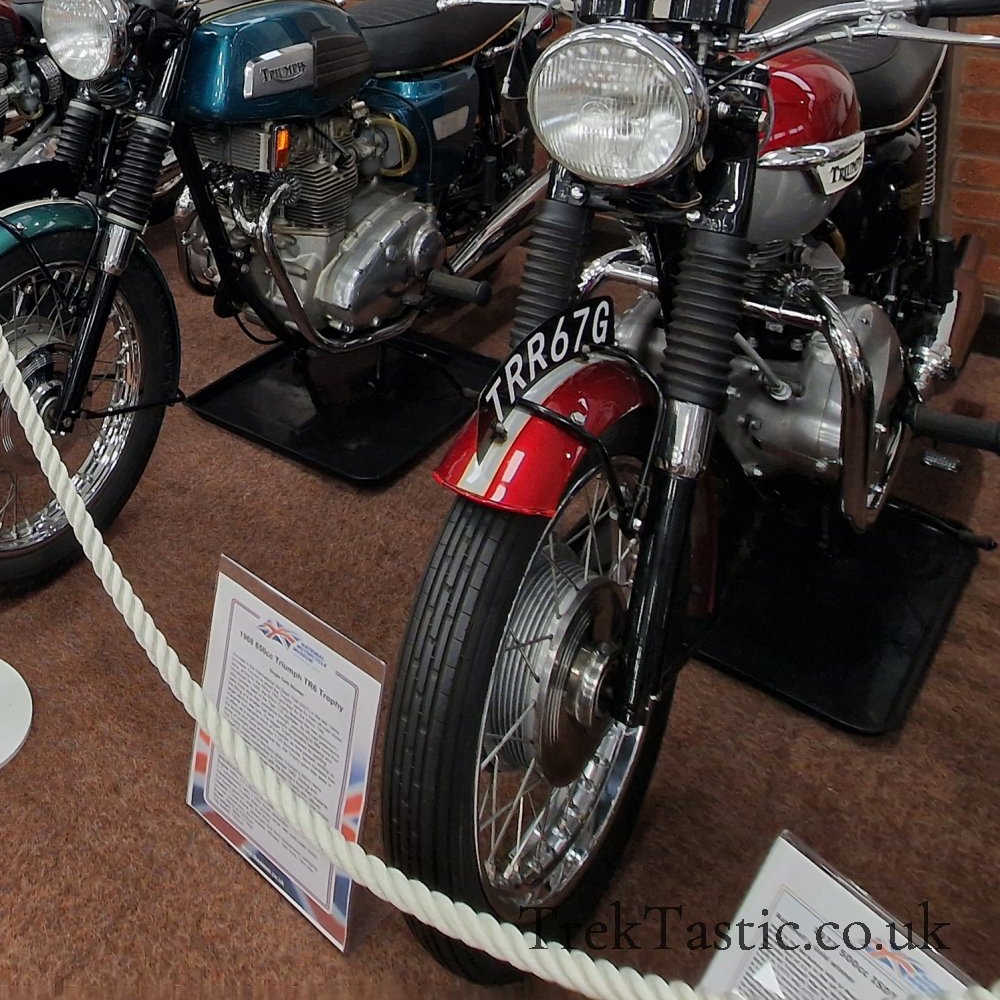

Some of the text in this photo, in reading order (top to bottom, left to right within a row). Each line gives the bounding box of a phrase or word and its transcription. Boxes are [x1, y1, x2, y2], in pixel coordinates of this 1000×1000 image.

[259, 60, 307, 82] TRIUMPH
[485, 300, 610, 424] TRR67G
[275, 655, 303, 681] Triumph
[319, 687, 345, 713] Trophy
